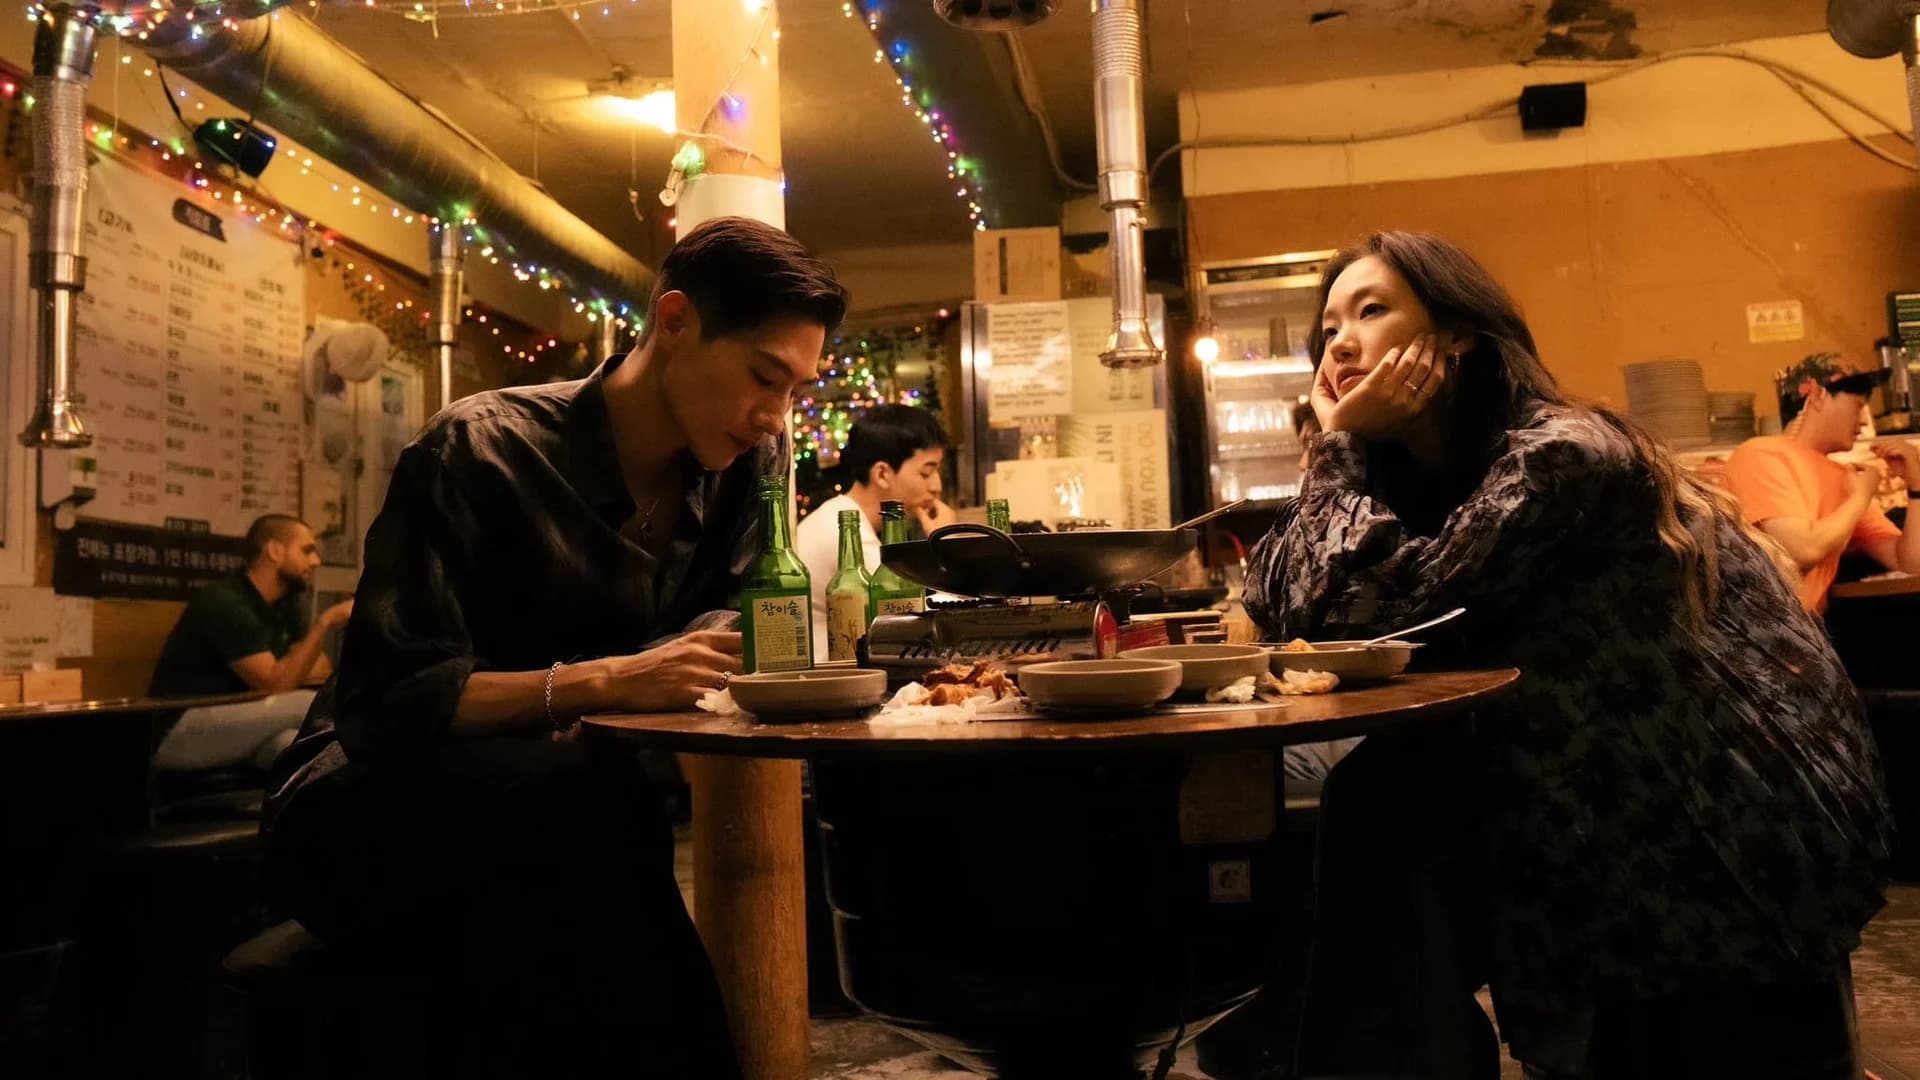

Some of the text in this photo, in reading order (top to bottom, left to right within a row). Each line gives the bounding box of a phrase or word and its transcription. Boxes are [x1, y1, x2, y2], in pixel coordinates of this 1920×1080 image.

[1095, 425, 1112, 444] IN
[1137, 423, 1154, 448] DO
[1140, 455, 1156, 492] YOU
[760, 600, 799, 616] 참이슬
